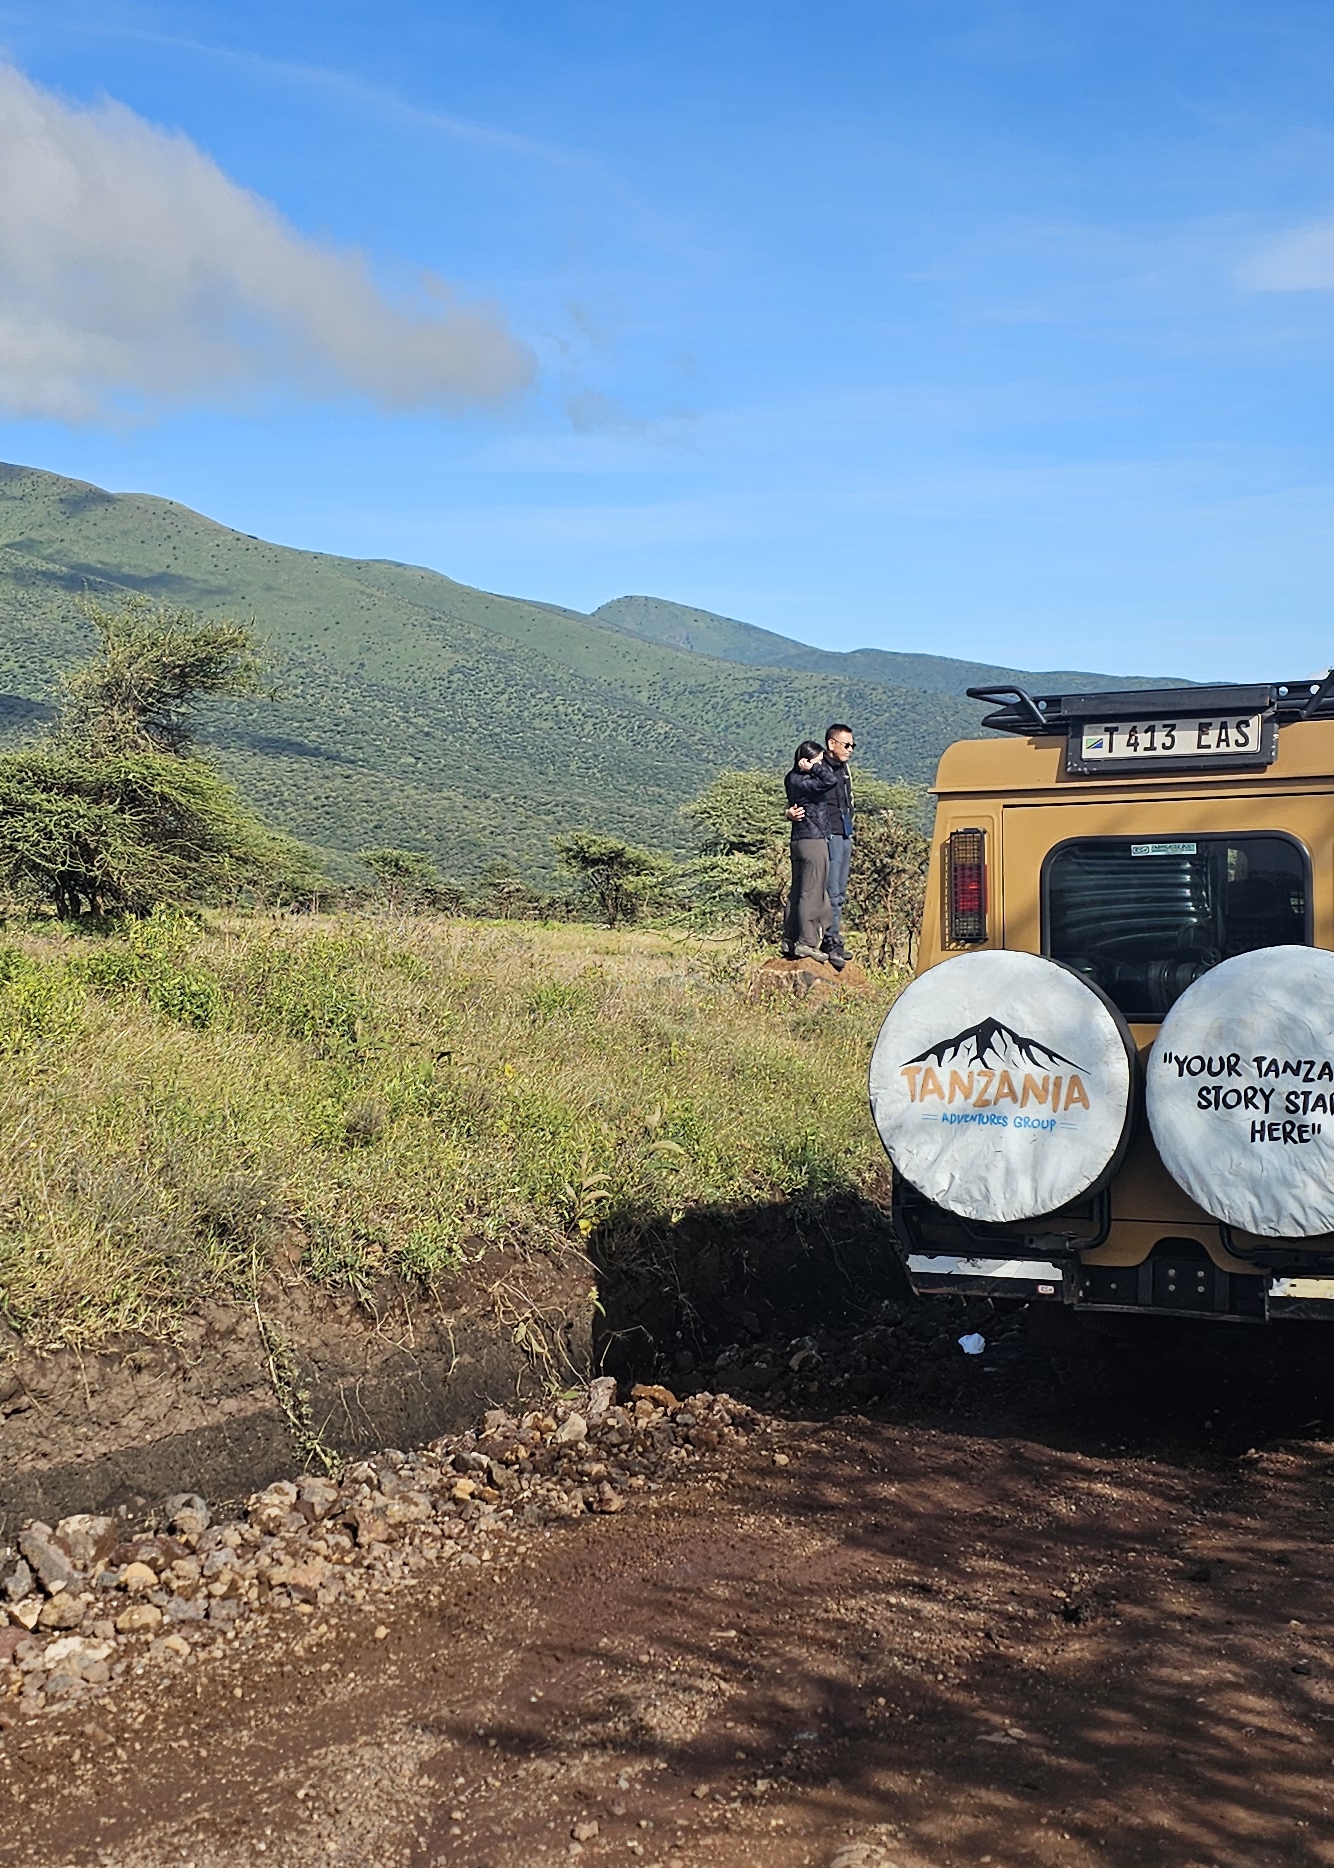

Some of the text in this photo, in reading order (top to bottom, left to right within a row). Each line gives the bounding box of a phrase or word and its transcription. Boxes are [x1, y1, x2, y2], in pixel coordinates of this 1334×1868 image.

[1104, 719, 1250, 753] T 413 EAS
[1163, 1052, 1241, 1078] "YOUR
[900, 1065, 1091, 1113] TANZANIA
[1197, 1085, 1275, 1114] STORY
[941, 1112, 1056, 1132] ADVENTURES GROUP
[1250, 1120, 1322, 1145] HERE"
